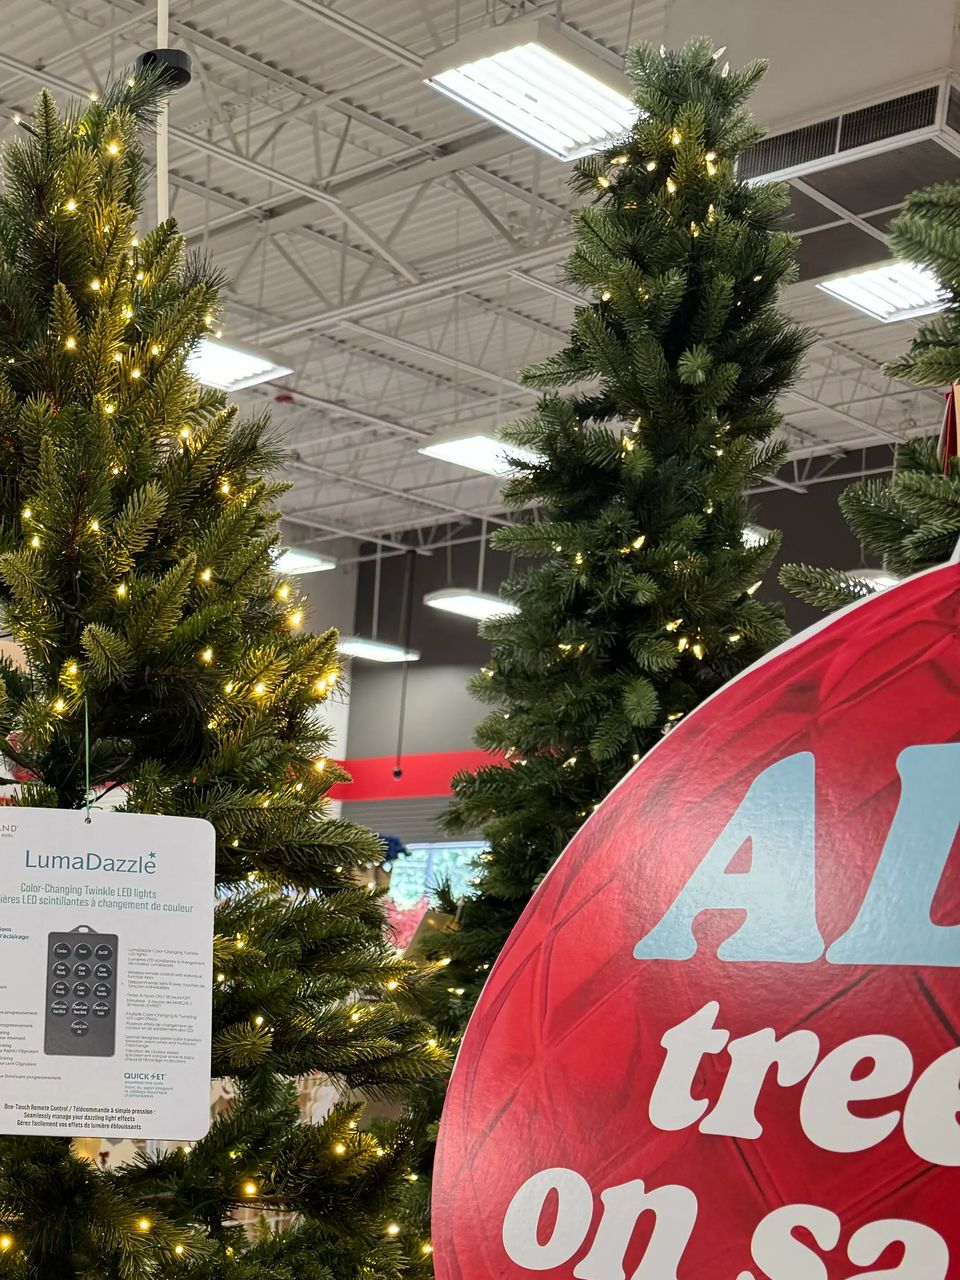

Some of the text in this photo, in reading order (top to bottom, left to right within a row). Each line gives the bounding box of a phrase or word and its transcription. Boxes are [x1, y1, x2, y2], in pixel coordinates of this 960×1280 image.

[25, 850, 157, 874] LumaDazzle
[21, 882, 157, 900] Color-Changing Twinkle LED lights
[22, 895, 37, 905] LED
[39, 896, 89, 907] scintillantes
[91, 898, 96, 908] à
[98, 899, 149, 911] changement
[151, 901, 161, 911] de
[163, 903, 194, 913] couleur
[115, 1107, 131, 1115] simple
[84, 1114, 104, 1122] dazzling
[110, 1122, 141, 1130] éblouissants
